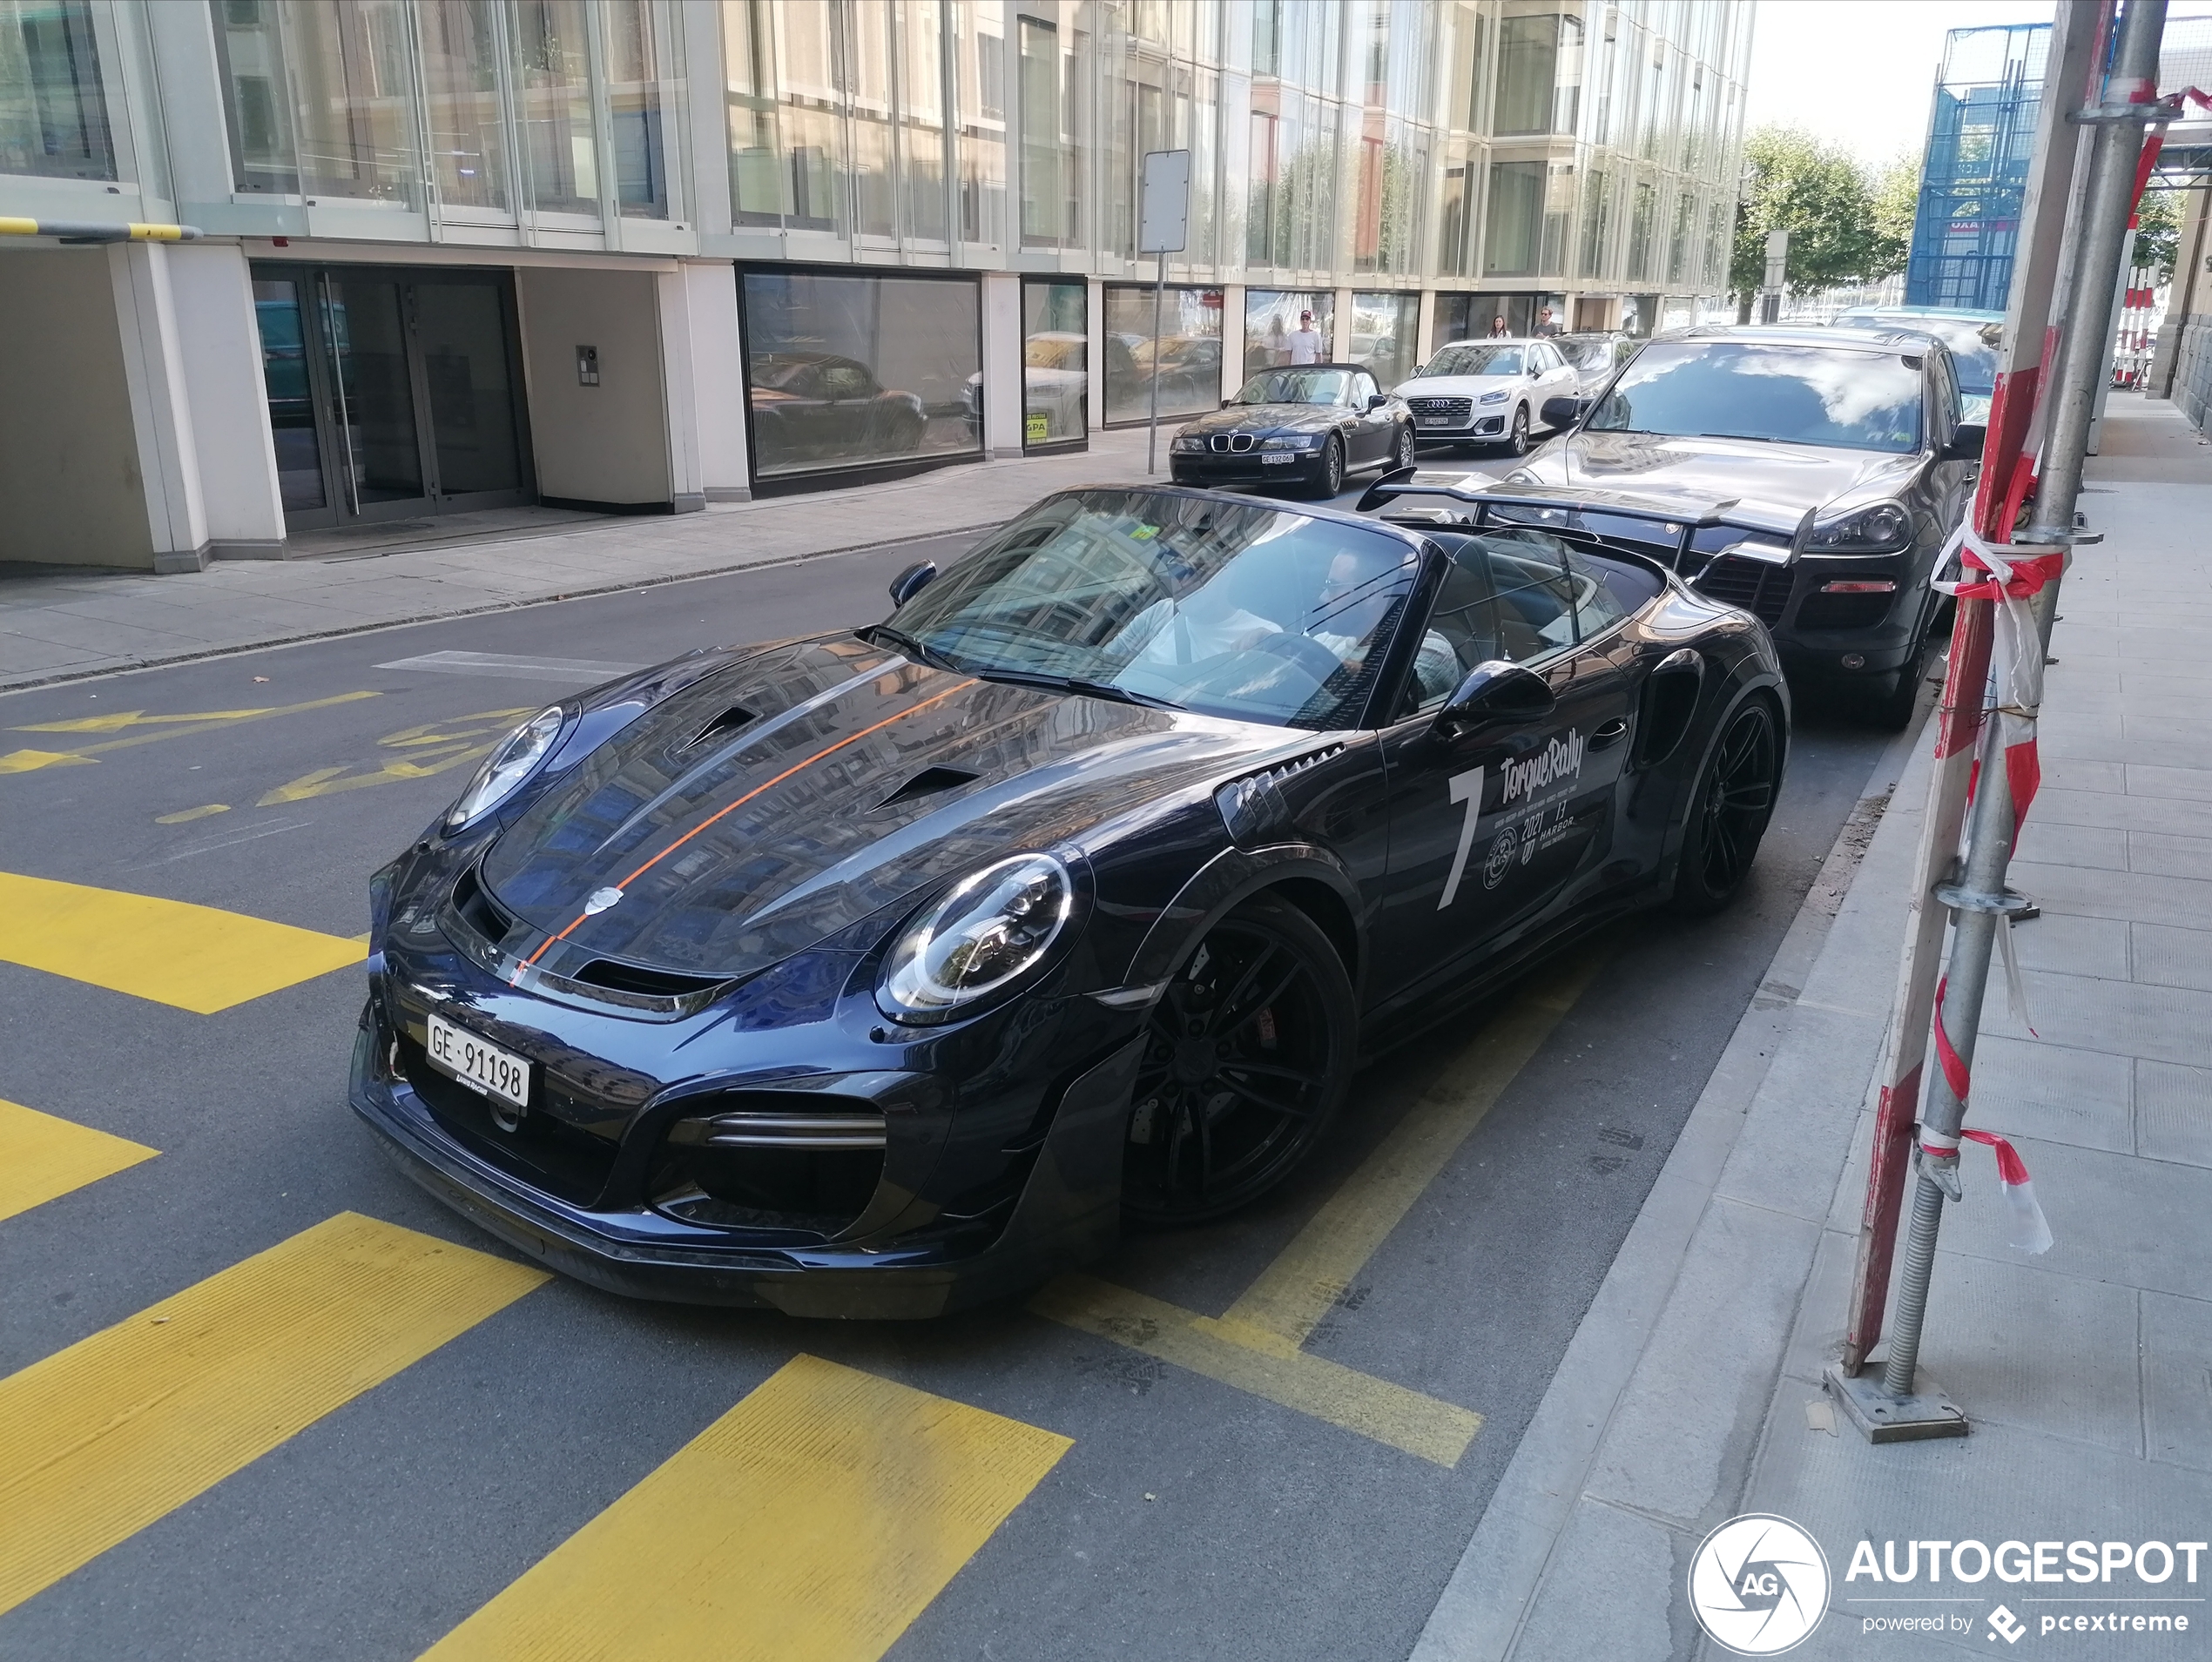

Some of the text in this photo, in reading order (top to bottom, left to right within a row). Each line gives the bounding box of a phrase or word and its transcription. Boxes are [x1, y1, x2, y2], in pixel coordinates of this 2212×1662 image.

[1436, 764, 1485, 912] 7
[1521, 810, 1545, 843] 2021
[1540, 816, 1575, 842] HARBOR
